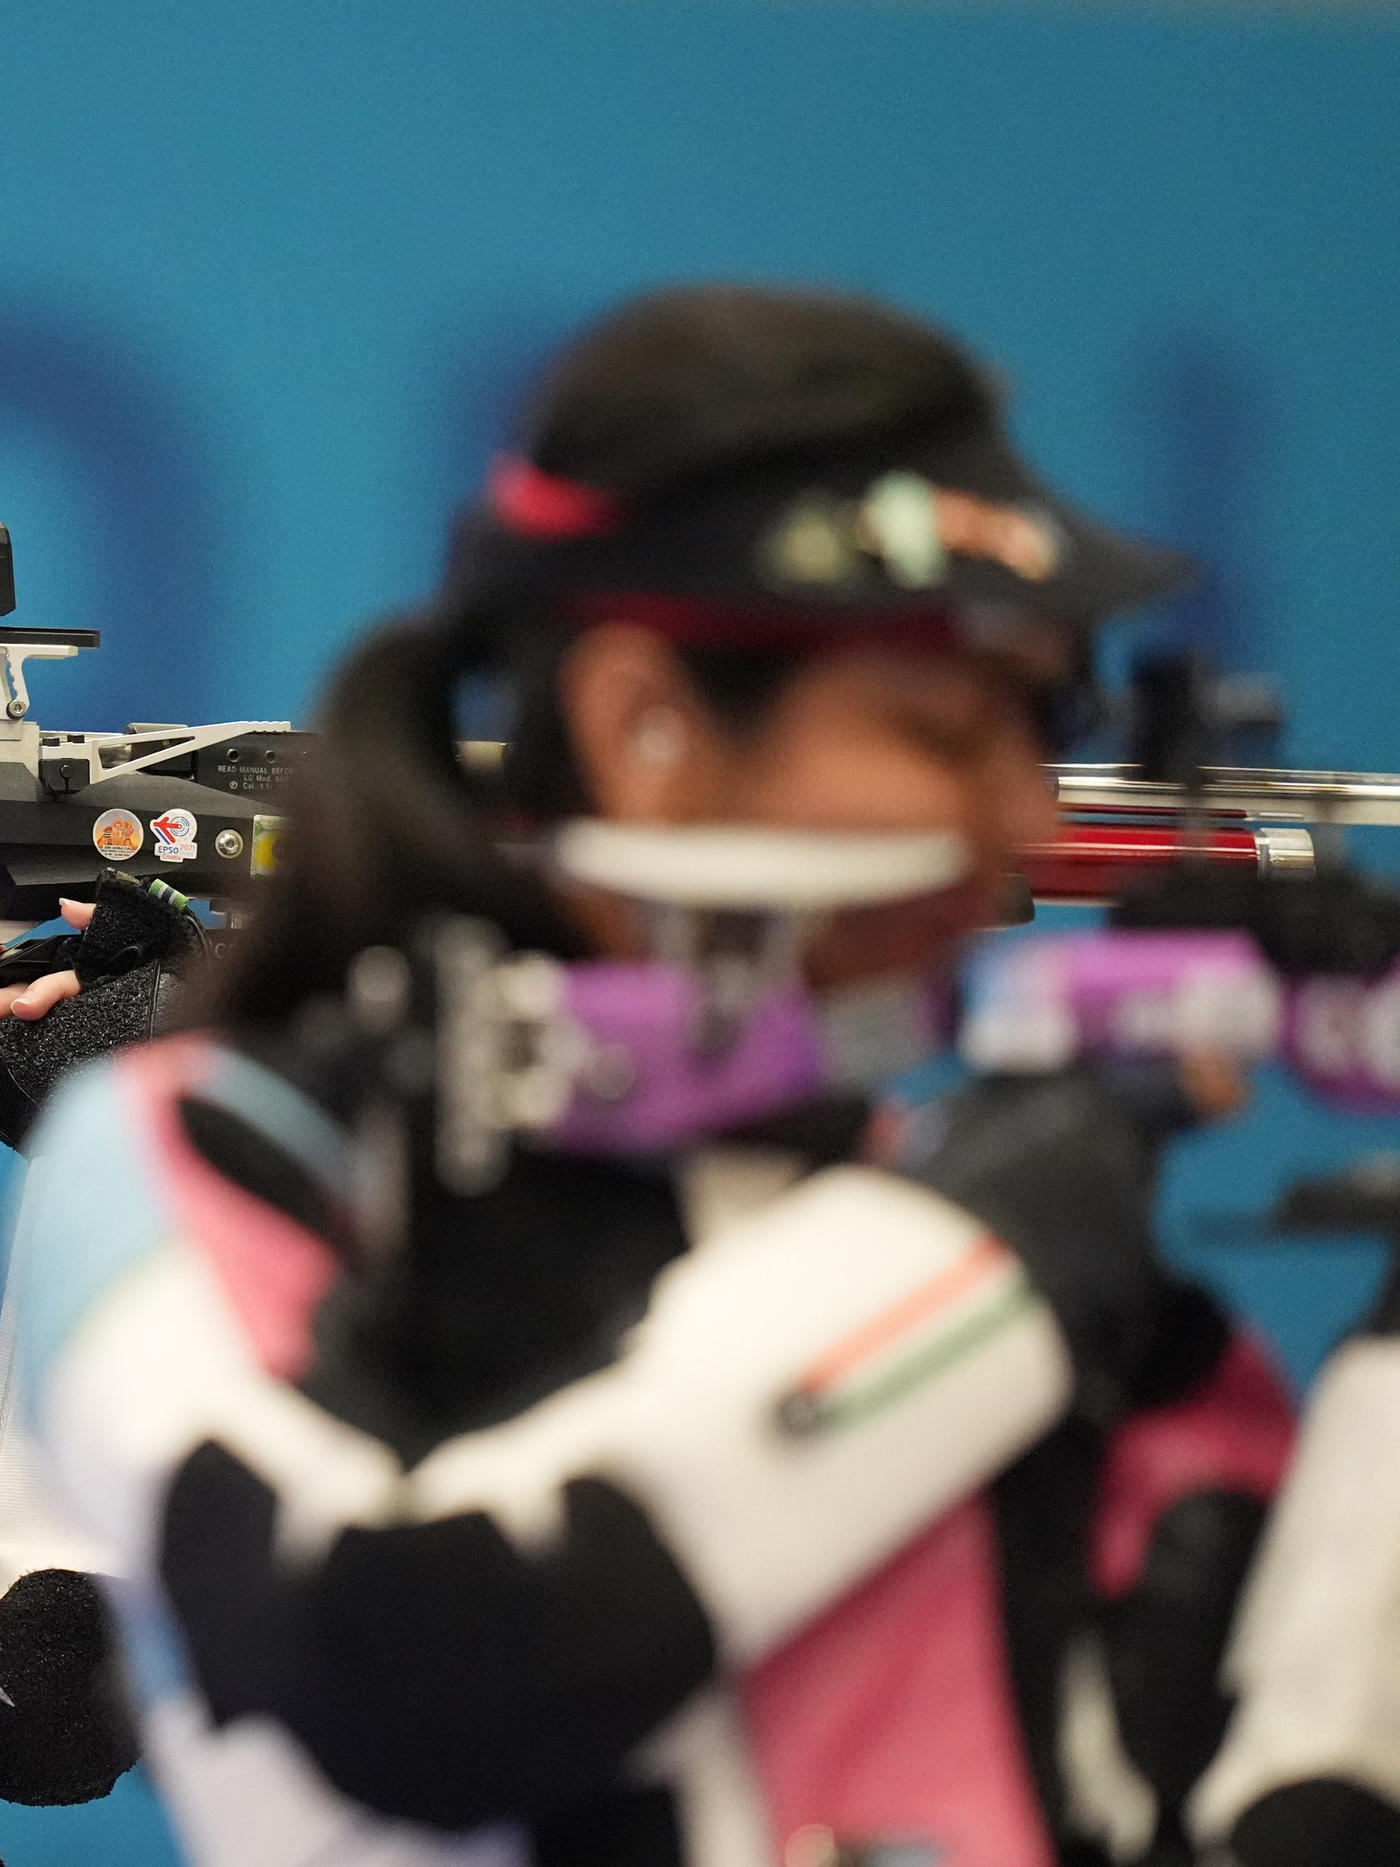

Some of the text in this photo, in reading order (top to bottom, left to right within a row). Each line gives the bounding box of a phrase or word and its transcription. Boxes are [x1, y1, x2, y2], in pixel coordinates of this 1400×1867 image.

[217, 765, 236, 773] READ
[240, 766, 268, 774] MANUAL
[158, 845, 179, 854] EPSO
